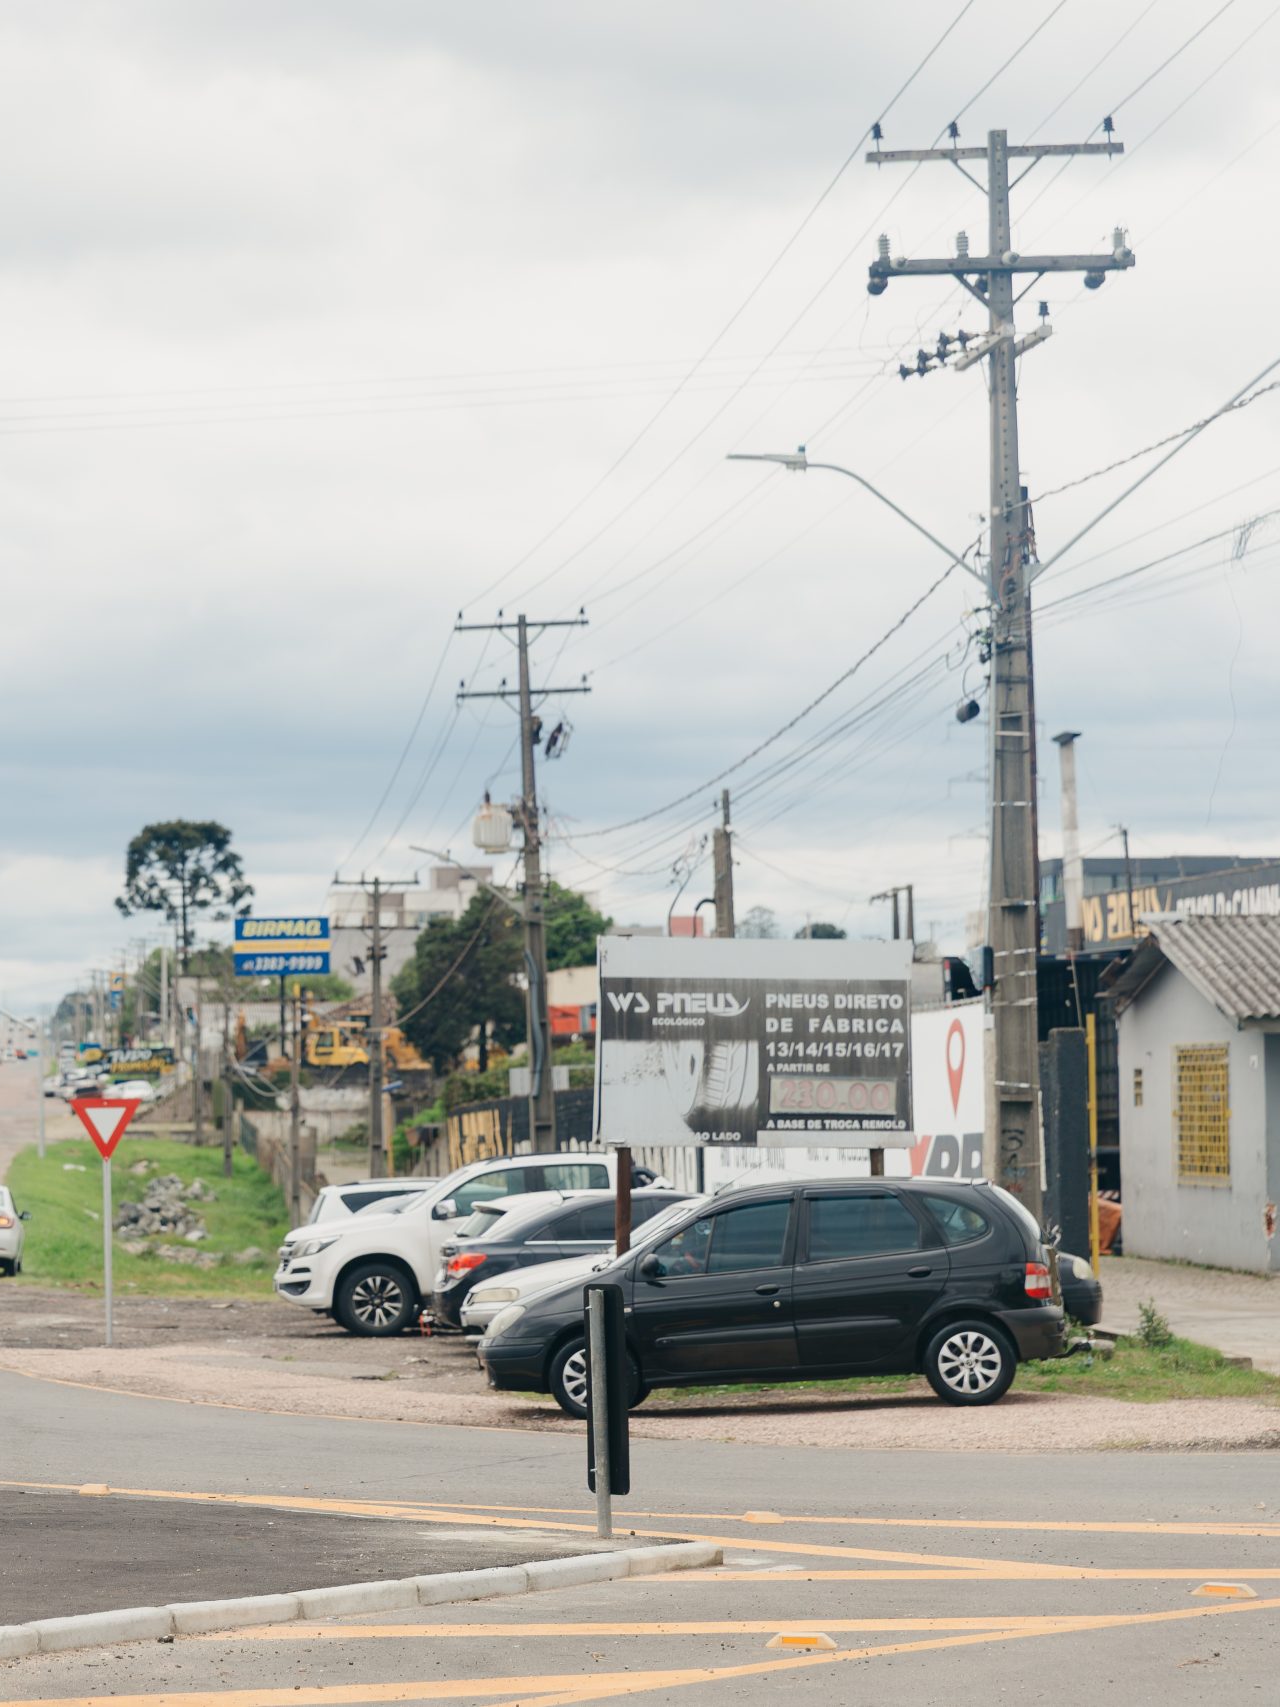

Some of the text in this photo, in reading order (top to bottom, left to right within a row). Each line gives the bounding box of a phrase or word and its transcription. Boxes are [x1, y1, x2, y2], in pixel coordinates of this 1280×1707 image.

[607, 992, 750, 1017] WS PNEUS
[766, 994, 904, 1009] PNEUS DIRETO
[652, 1017, 705, 1026] ECOLÓGICO
[766, 1015, 904, 1033] DE FÁBRICA
[766, 1042, 904, 1058] 13/14/15/16/17
[767, 1063, 830, 1072] A PARTIR DE
[766, 1120, 906, 1129] A BASE DE TROCA REMOLD
[712, 1131, 741, 1141] LADO
